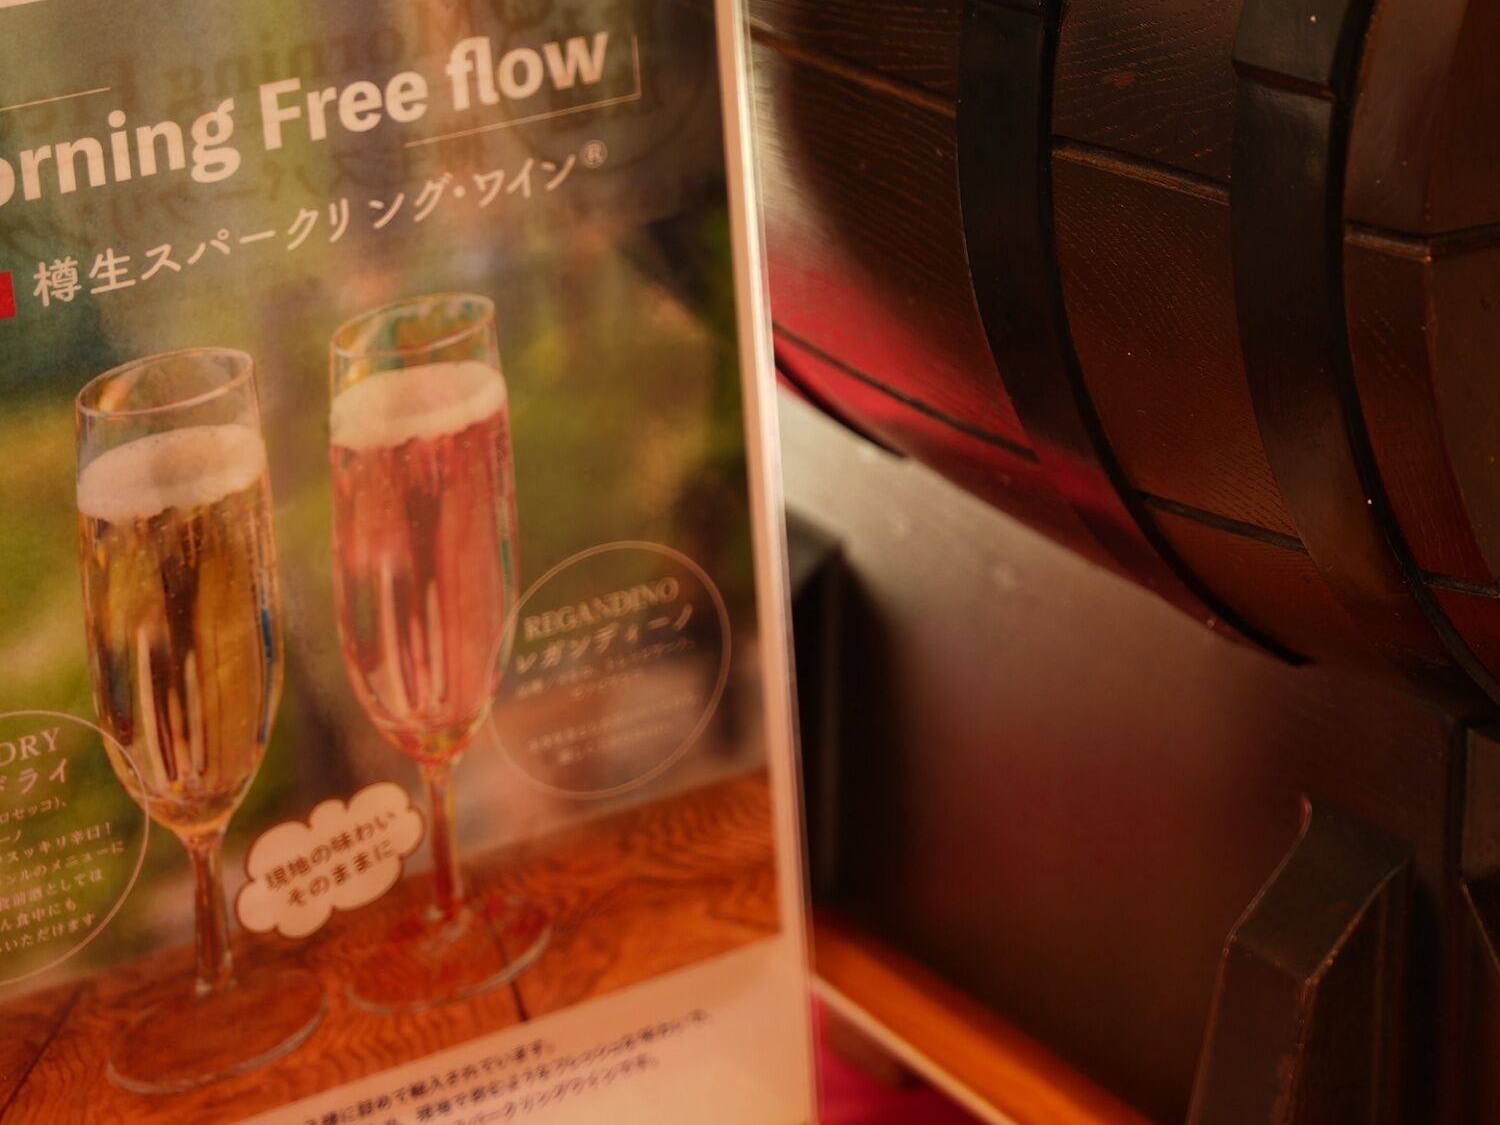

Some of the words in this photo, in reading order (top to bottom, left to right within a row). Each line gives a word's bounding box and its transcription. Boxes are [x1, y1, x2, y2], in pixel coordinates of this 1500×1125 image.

[258, 70, 429, 151] Free
[445, 30, 608, 112] flow
[264, 810, 397, 892] 現地の味わい
[287, 839, 396, 908] そのままに
